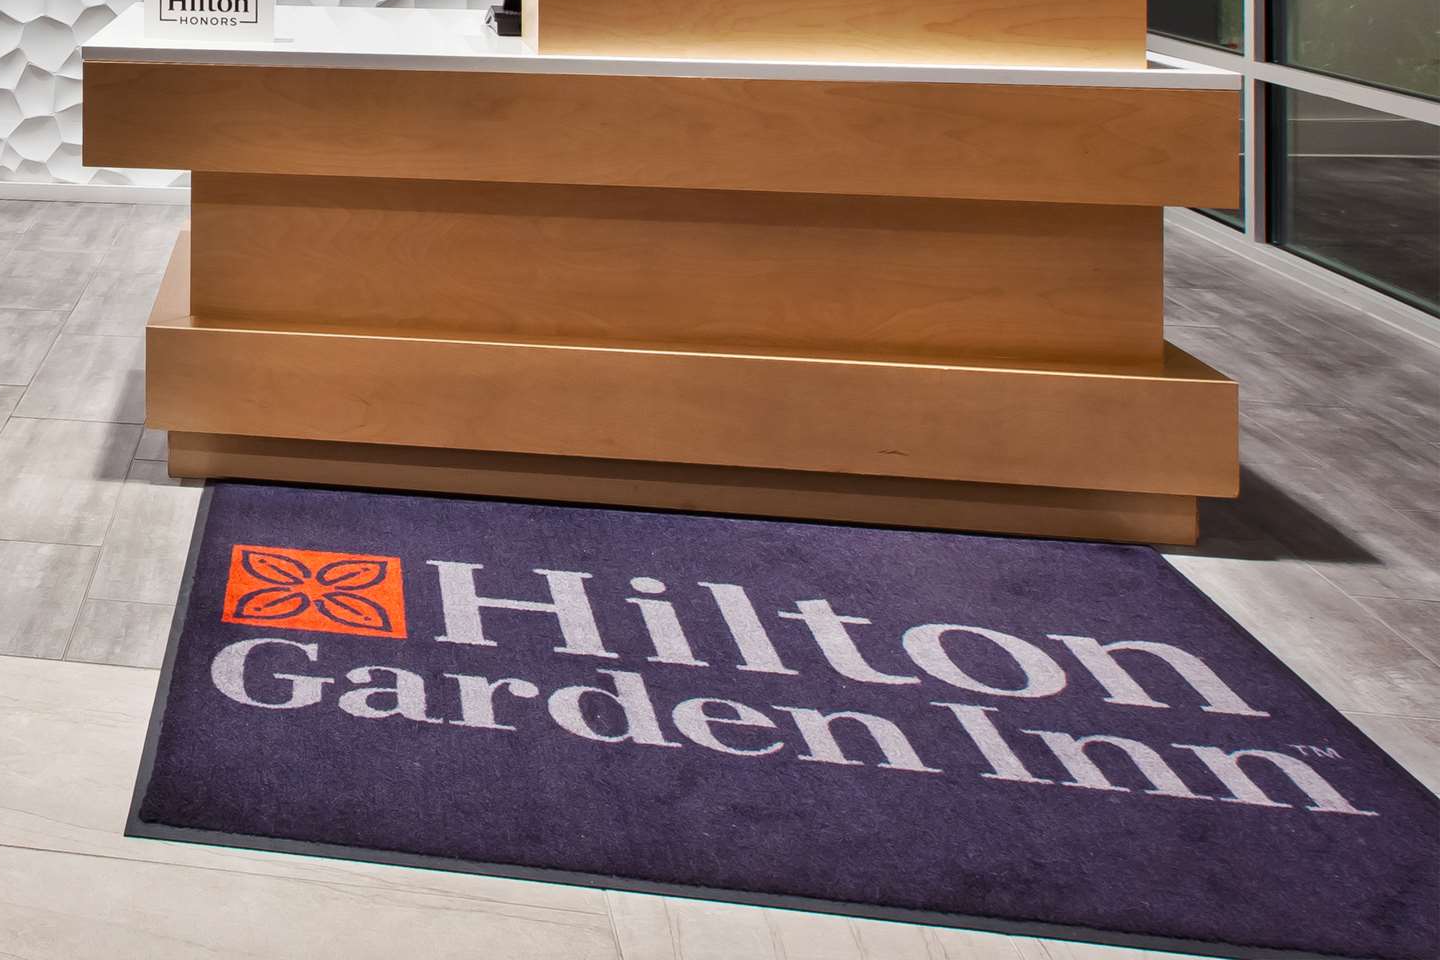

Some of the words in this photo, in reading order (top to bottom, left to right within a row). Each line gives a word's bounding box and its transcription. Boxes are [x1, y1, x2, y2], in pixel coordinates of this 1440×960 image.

[179, 15, 238, 27] HONORS
[425, 559, 1270, 717] Hilton
[210, 637, 943, 774] Garden
[929, 701, 1380, 817] Inn
